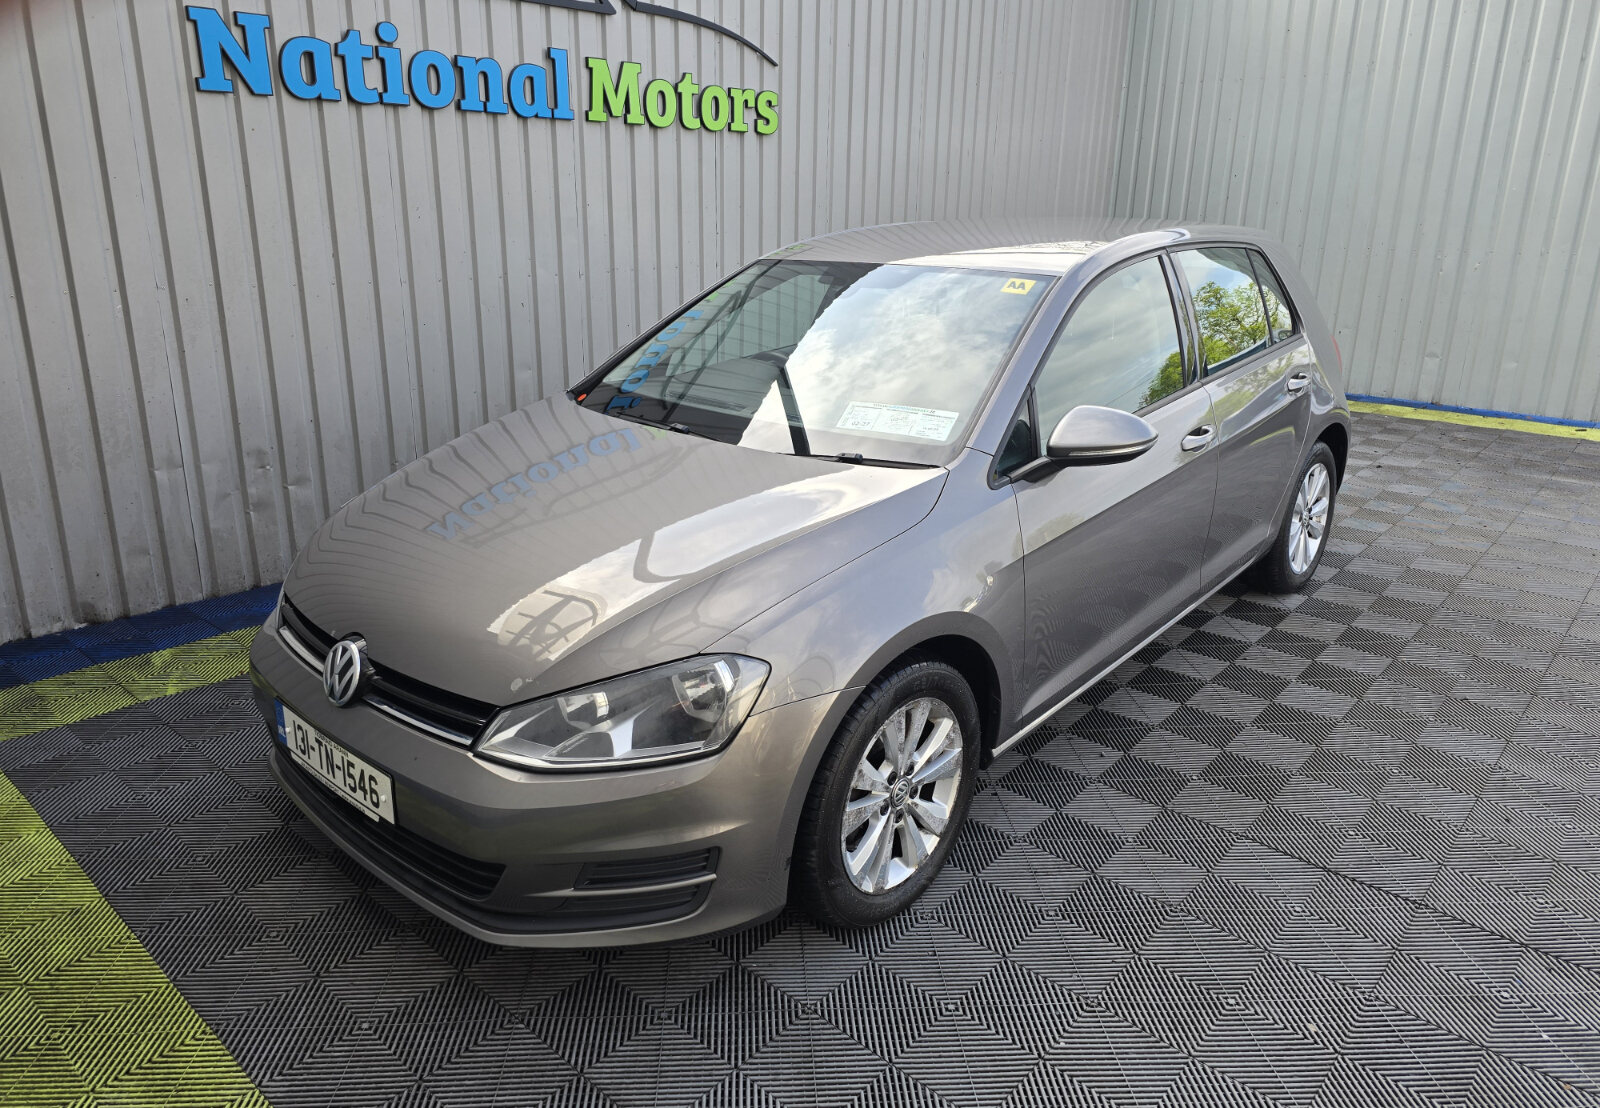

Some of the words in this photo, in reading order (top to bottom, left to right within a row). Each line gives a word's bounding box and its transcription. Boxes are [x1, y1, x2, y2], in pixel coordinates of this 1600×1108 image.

[186, 5, 574, 121] National
[585, 56, 779, 135] Motors
[1007, 280, 1026, 291] AA
[293, 720, 380, 809] 131-TN-1546
